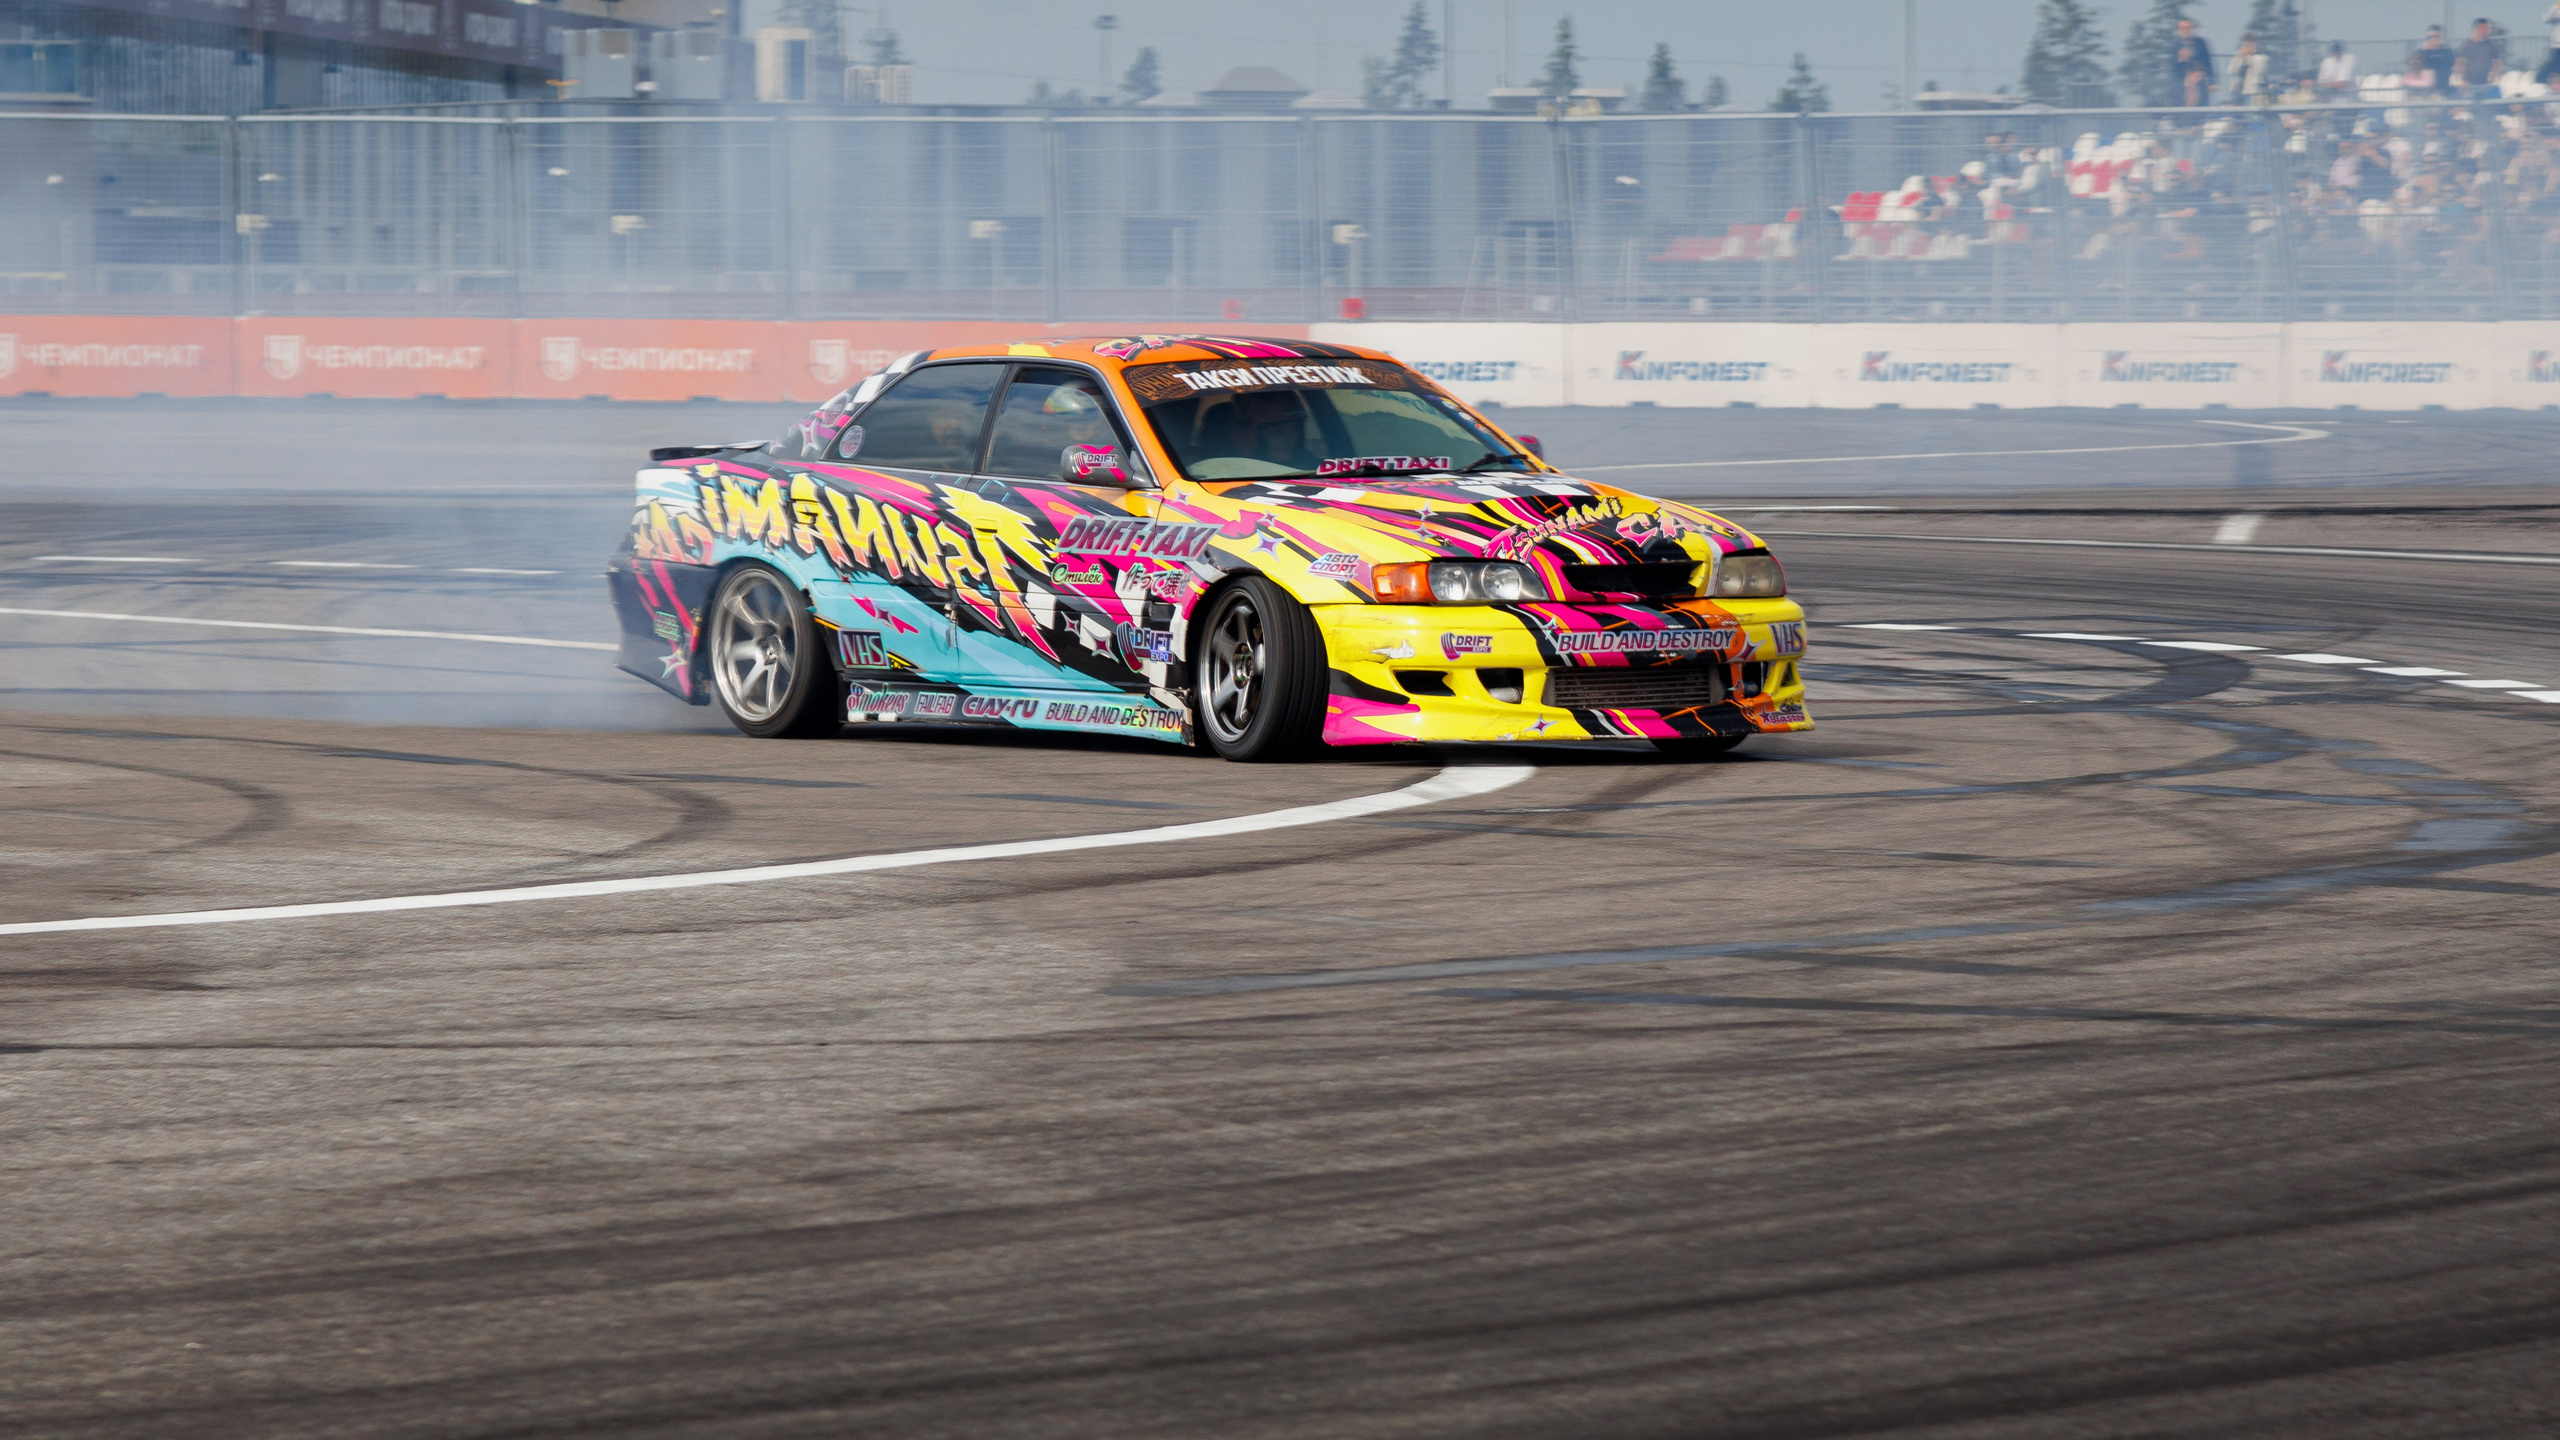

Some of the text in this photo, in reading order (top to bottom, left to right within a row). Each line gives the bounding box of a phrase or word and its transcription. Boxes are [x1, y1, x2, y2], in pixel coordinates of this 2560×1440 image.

[22, 344, 203, 367] ЧЕМПИОНАТ
[304, 345, 486, 368] ЧЕМПИОНАТ
[581, 348, 757, 371] ЧЕМПИОНАТ
[1173, 367, 1260, 391] ТАКСИ
[1250, 364, 1374, 385] ПРЕСТИЖ
[1319, 457, 1448, 472] DRIFT TAXI
[1311, 562, 1356, 573] СПОРТ
[1324, 554, 1359, 563] АВТО
[843, 635, 885, 665] VHS
[1135, 628, 1174, 652] DRIFT
[1456, 636, 1492, 646] DRIFT
[1559, 629, 1736, 651] BUILD AND DESTROY
[1772, 624, 1804, 655] VHS
[1151, 654, 1169, 662] EXPO
[847, 684, 908, 712] Smokers
[1045, 702, 1183, 731] BUILD AND DESTROY
